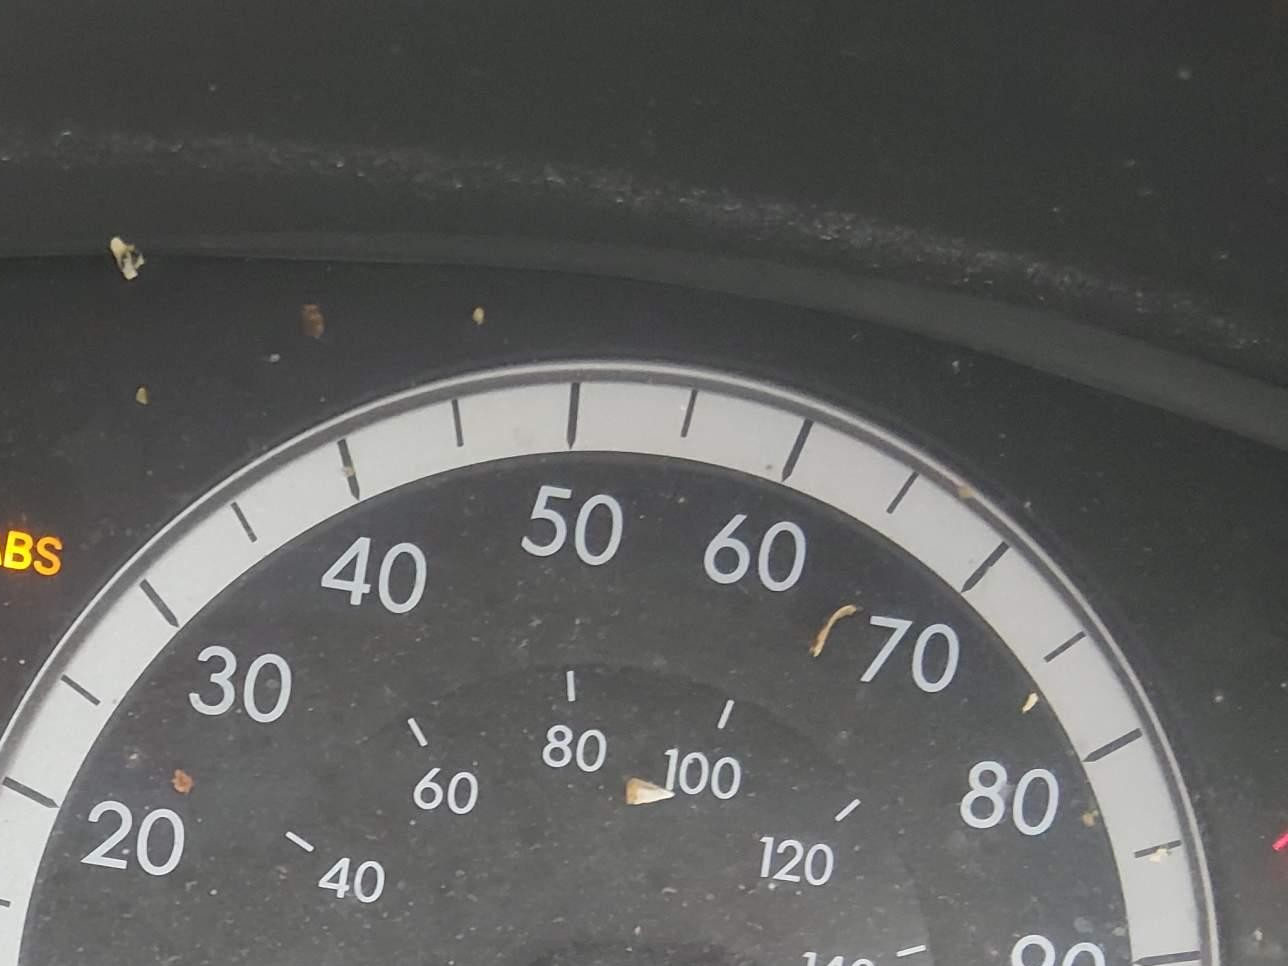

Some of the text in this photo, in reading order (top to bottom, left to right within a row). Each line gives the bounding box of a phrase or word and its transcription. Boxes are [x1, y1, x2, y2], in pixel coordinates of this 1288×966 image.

[520, 484, 624, 566] 50
[703, 514, 807, 592] 60
[320, 537, 427, 614] 40
[188, 645, 293, 723] 30
[860, 614, 960, 693] 70
[542, 724, 608, 773] 80
[664, 748, 743, 800] 100
[413, 767, 479, 815] 60
[959, 760, 1060, 836] 80
[80, 800, 186, 876] 20
[758, 836, 835, 886] 120
[318, 857, 386, 904] 40
